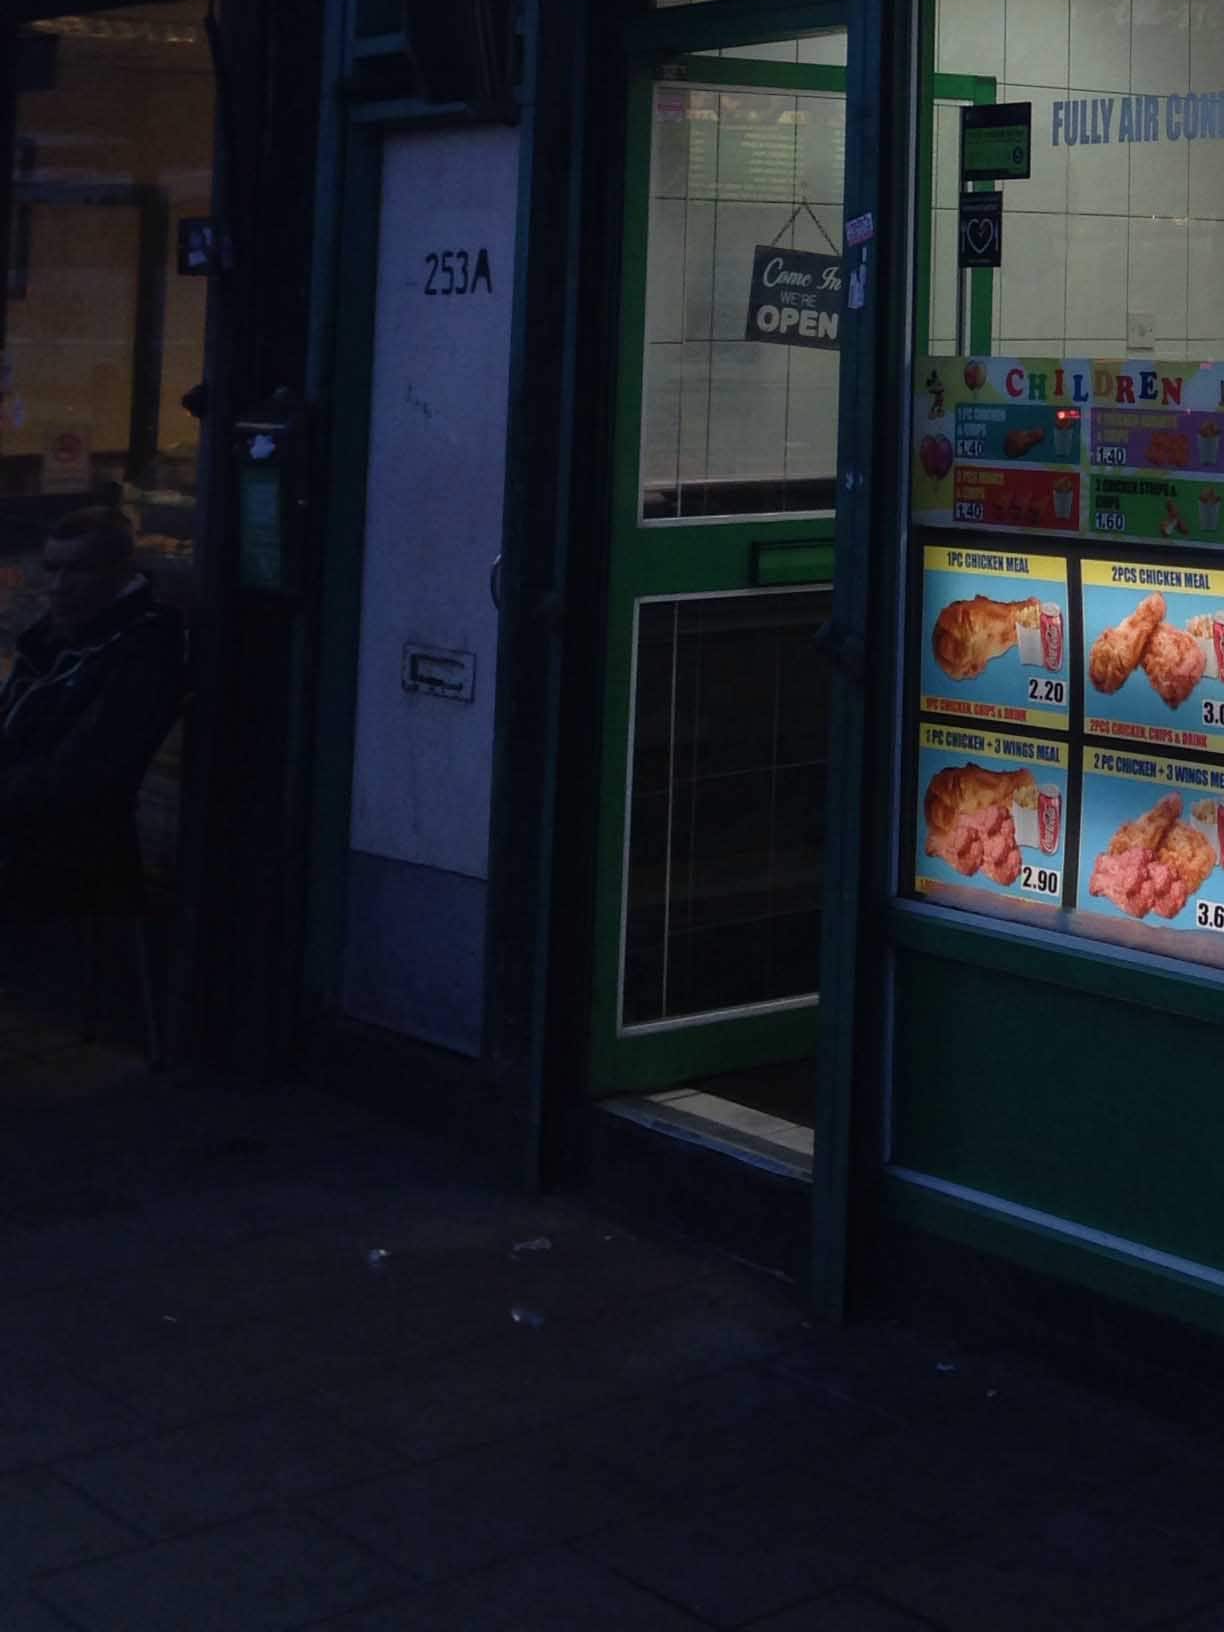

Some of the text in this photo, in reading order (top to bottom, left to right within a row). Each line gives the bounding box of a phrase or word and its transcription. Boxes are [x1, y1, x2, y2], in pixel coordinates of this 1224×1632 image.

[1051, 97, 1115, 146] FULLY
[1118, 93, 1160, 144] AIR
[423, 248, 494, 296] 253A
[763, 256, 843, 291] Come In
[756, 304, 840, 340] OPEN
[1005, 366, 1184, 407] CHILDREN
[964, 554, 1005, 573] CHICKEN
[1006, 557, 1030, 574] MEAL
[1111, 566, 1211, 590] 2PCS CHICKEN MEAL
[1029, 678, 1064, 704] 2.20
[945, 732, 985, 753] CHICKEN
[994, 738, 1001, 755] 3
[1002, 740, 1035, 761] WINGS
[1035, 744, 1061, 764] MEAL
[1093, 753, 1100, 769] 2
[1115, 755, 1157, 778] CHICKEN
[1166, 762, 1173, 780] 3
[1174, 764, 1209, 788] WINGS
[1022, 866, 1059, 894] 2.90
